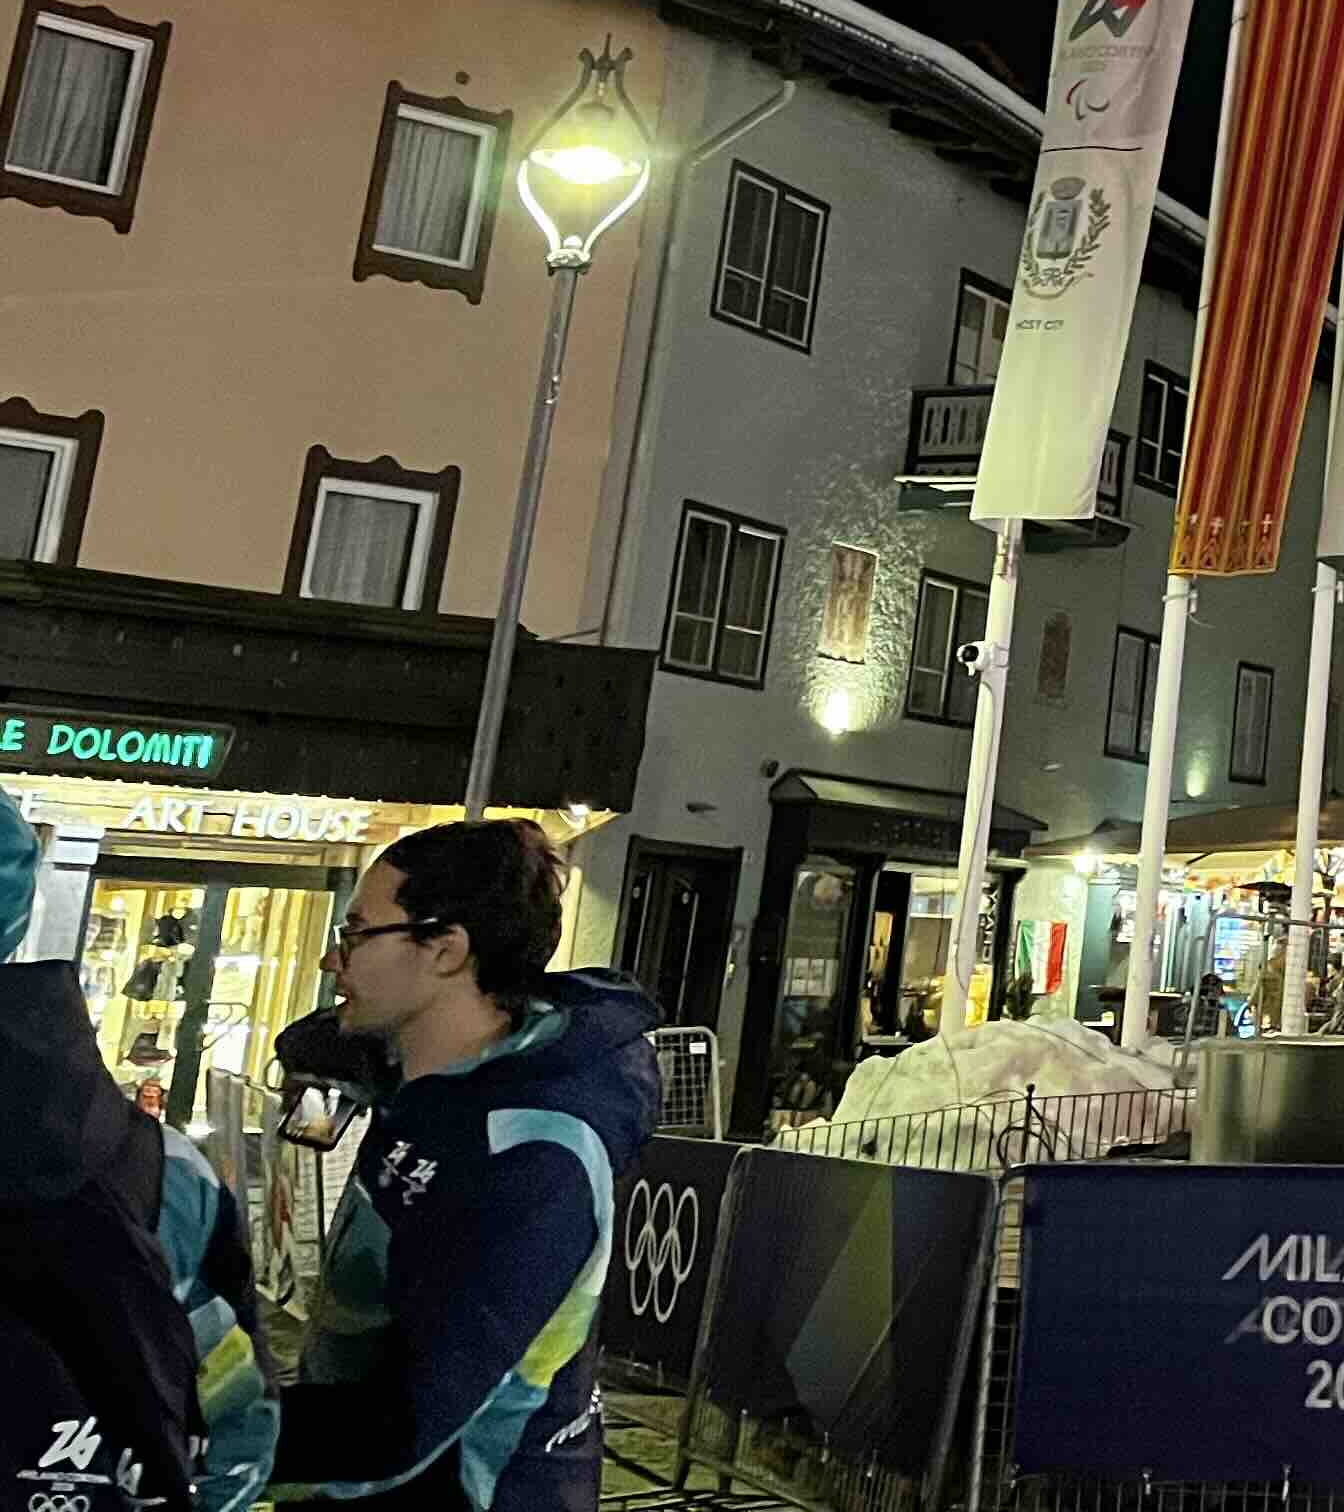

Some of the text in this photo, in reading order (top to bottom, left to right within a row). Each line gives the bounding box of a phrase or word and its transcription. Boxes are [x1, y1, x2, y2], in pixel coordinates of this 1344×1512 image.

[0, 718, 214, 768] E DOLOMITI
[123, 796, 210, 833] ART
[231, 803, 372, 842] HOUSE
